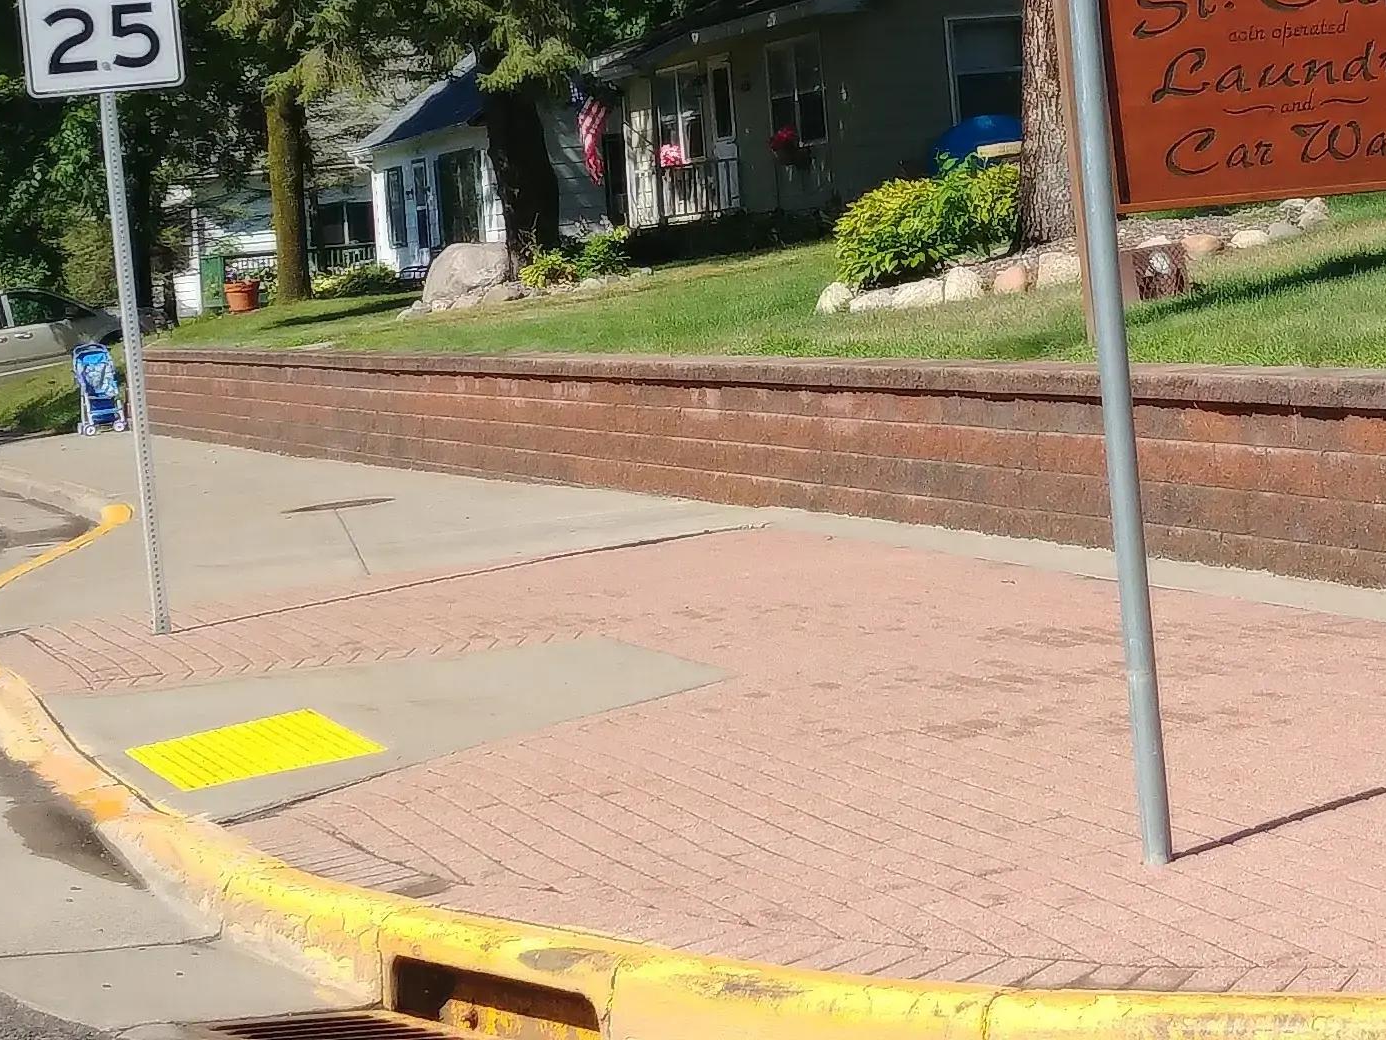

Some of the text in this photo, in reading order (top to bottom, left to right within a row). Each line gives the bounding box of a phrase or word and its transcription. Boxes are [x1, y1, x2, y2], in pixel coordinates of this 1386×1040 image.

[43, 1, 161, 76] 25
[1228, 10, 1349, 48] coin operated
[1280, 88, 1316, 114] and
[1164, 128, 1273, 176] Car
